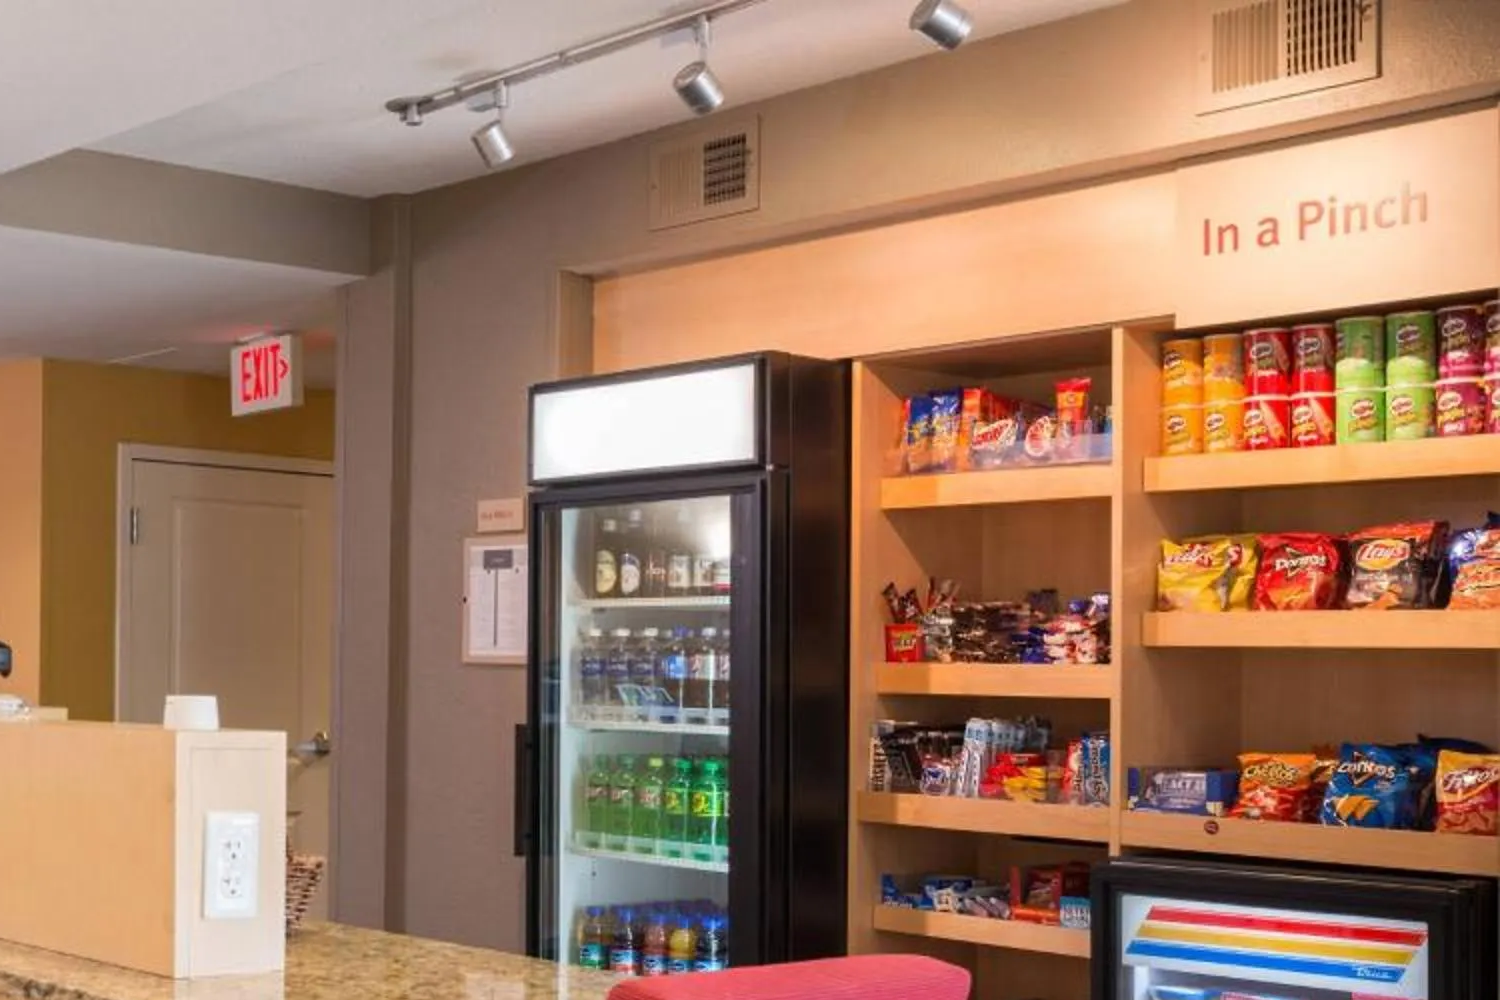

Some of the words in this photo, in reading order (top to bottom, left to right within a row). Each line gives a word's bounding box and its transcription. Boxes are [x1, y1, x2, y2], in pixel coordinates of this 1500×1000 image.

[1203, 218, 1239, 256] In
[1256, 216, 1280, 248] a
[1298, 180, 1428, 241] Pinch
[241, 343, 281, 403] EXIT
